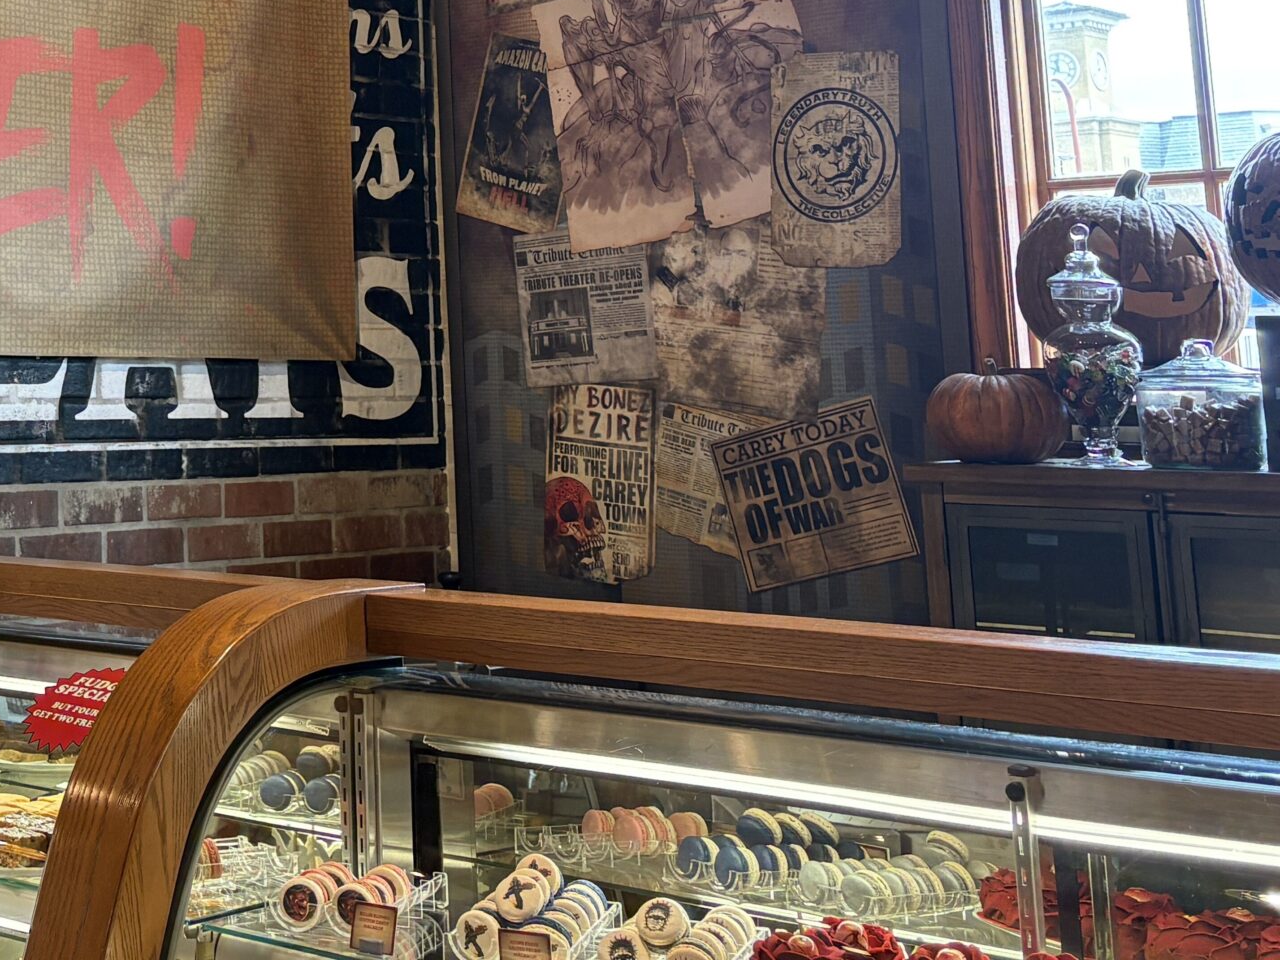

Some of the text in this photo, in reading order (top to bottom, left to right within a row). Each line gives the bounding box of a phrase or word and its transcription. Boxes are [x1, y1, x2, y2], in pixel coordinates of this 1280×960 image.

[480, 166, 548, 196] FROM PLANET
[797, 199, 820, 217] THE
[523, 267, 643, 291] TRIBUTE THEATER RE-OPENS
[587, 386, 650, 414] BONEZ
[554, 406, 650, 443] DEZIRE
[680, 409, 725, 433] Tribute
[723, 431, 787, 465] CAREY
[791, 410, 866, 446] TODAY
[554, 442, 607, 460] PERFORMING
[553, 454, 607, 479] FOR THE
[607, 448, 649, 483] LIVE!
[723, 462, 775, 504] THE
[771, 433, 890, 507] DOGS
[592, 477, 648, 507] CAREY
[604, 503, 647, 526] TOWN
[744, 498, 783, 545] OF
[784, 497, 845, 535] WAR
[54, 684, 112, 703] SPECIA
[73, 676, 118, 691] FUDG
[32, 709, 95, 728] GET TWO FRE
[51, 702, 100, 717] BUY FOUR
